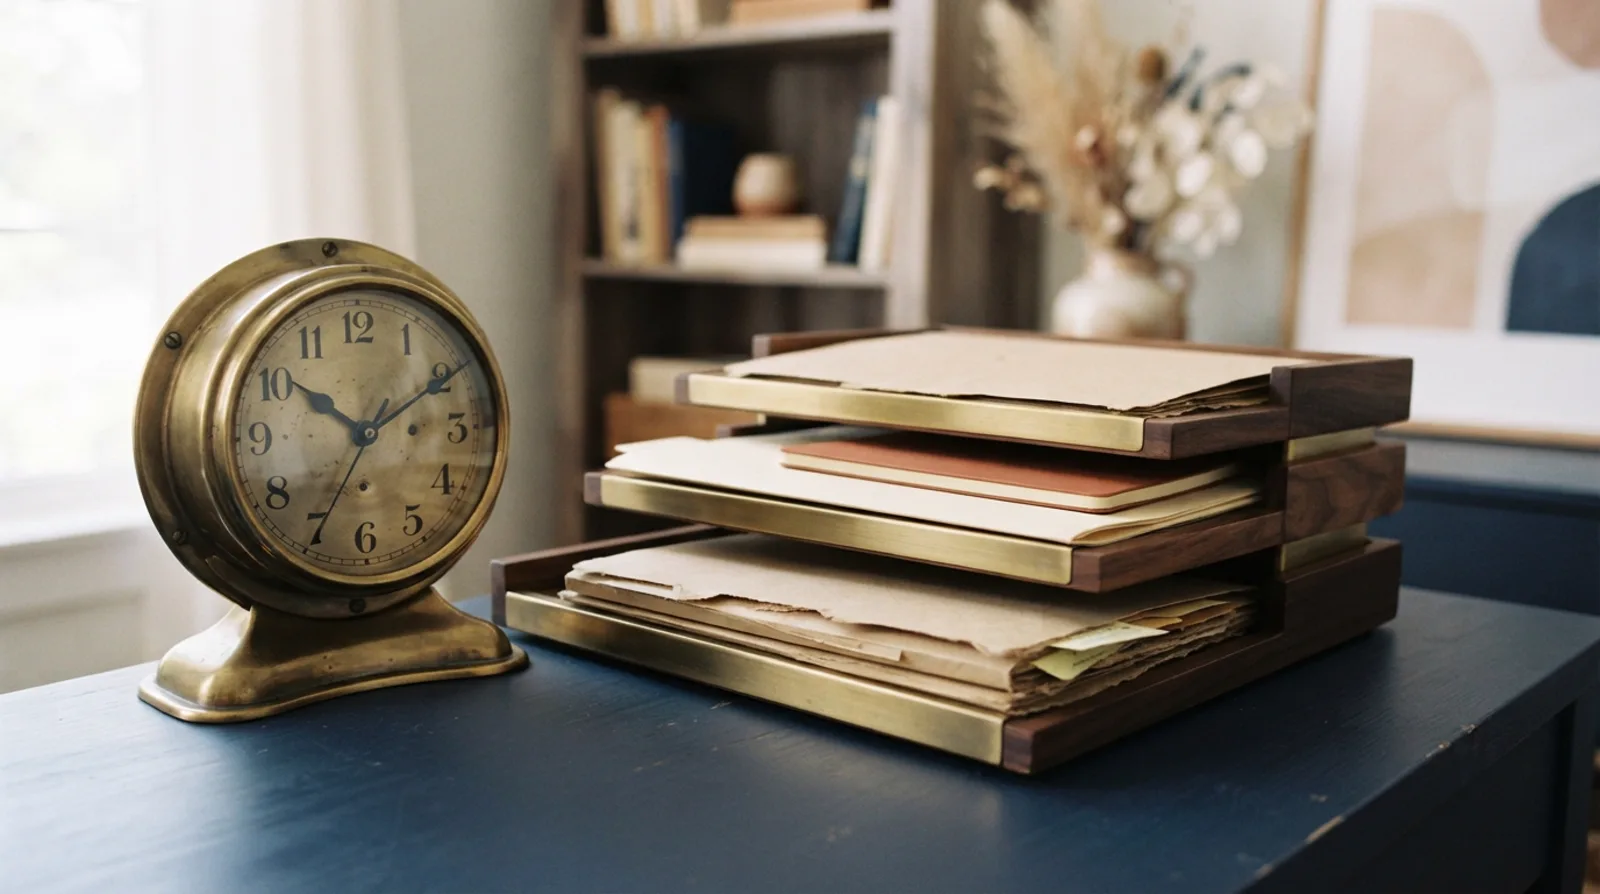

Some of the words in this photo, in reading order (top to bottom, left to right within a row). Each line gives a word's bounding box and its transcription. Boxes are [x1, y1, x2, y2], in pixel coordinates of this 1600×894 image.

[299, 325, 324, 359] 11
[341, 310, 375, 344] 12
[401, 323, 412, 356] 1
[258, 367, 294, 402] 10
[431, 362, 453, 394] 2
[248, 421, 273, 456] 9
[447, 412, 468, 444] 3
[265, 475, 290, 510] 8
[431, 463, 456, 495] 4
[306, 511, 328, 546] 7
[402, 504, 423, 536] 5
[354, 521, 377, 554] 6
